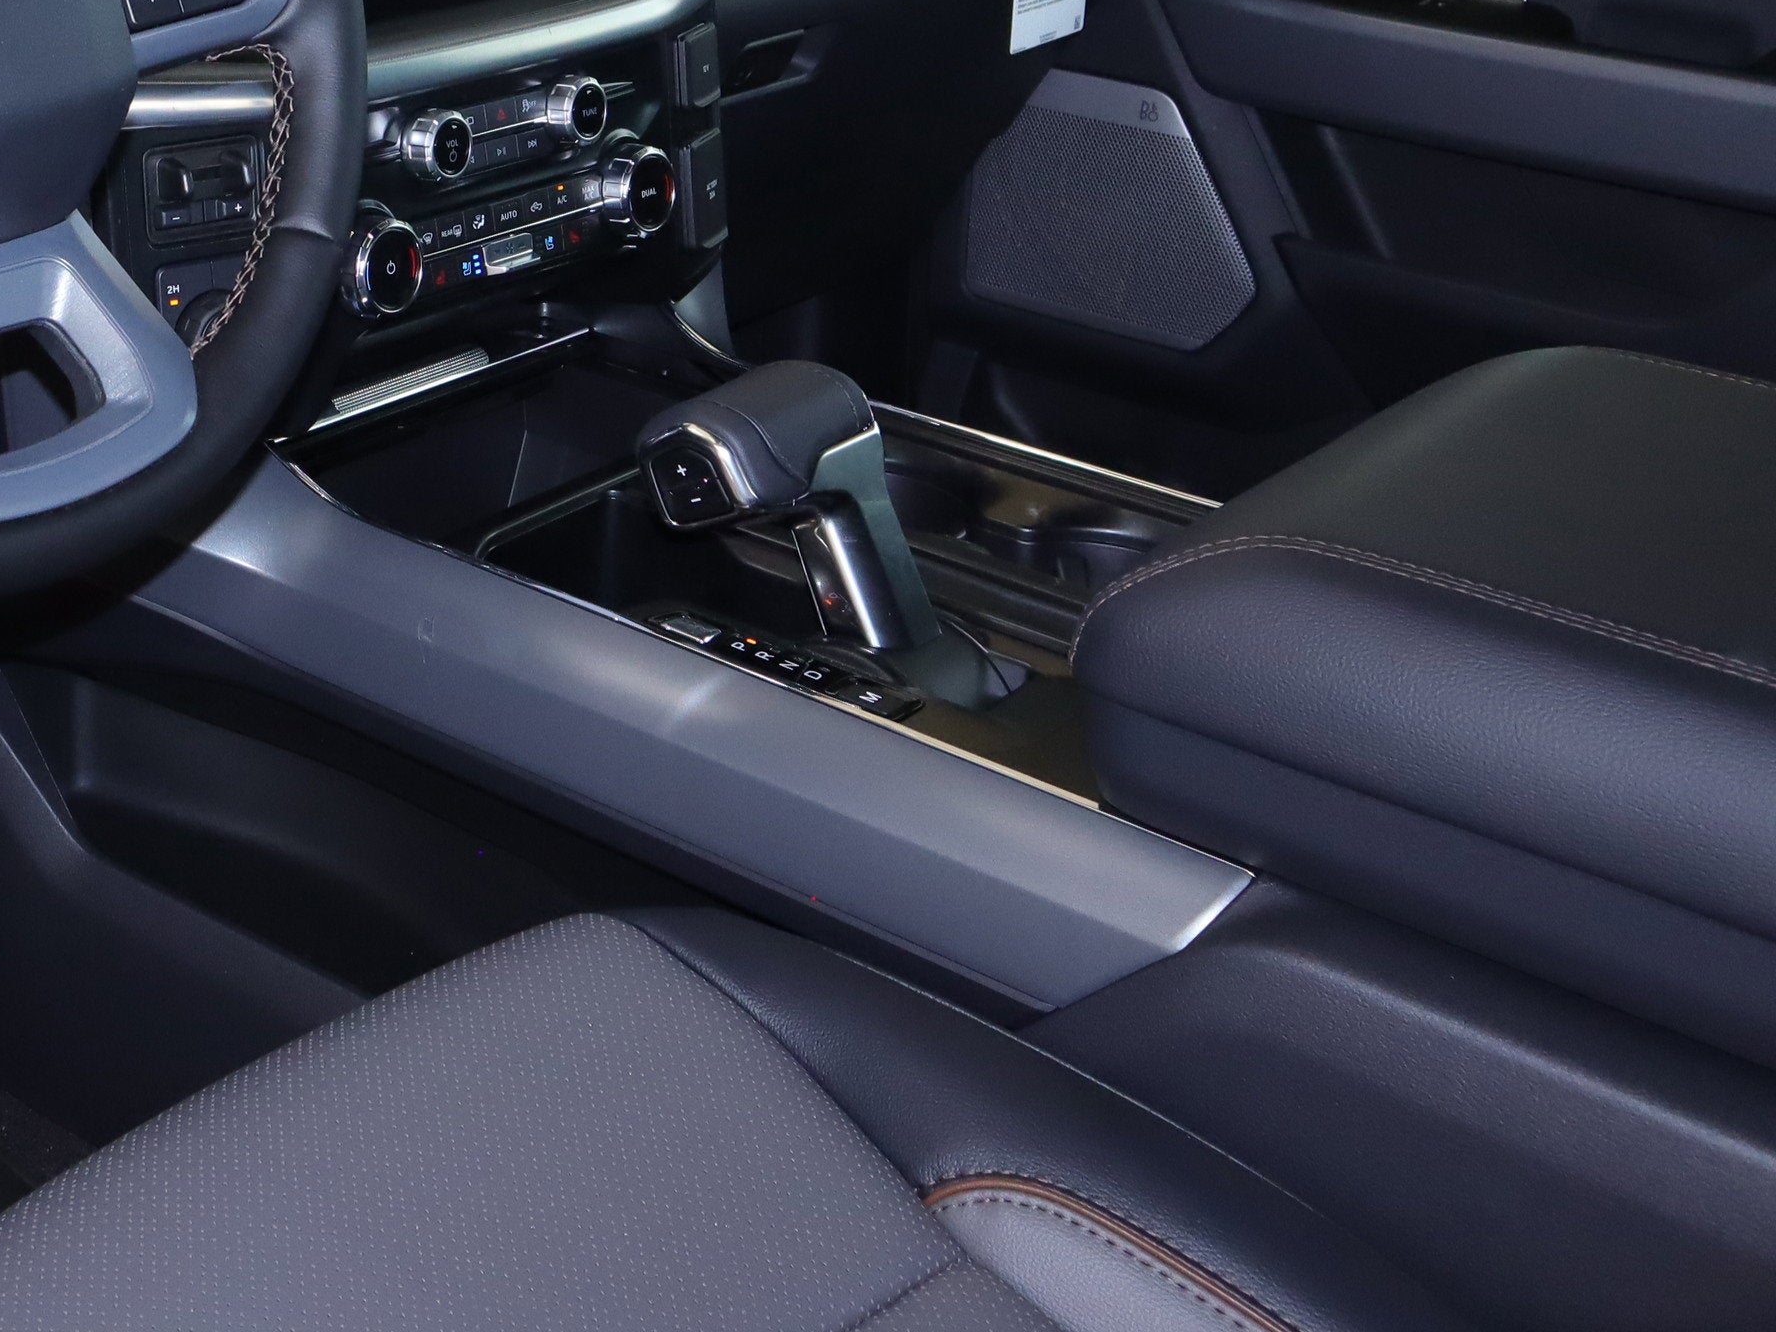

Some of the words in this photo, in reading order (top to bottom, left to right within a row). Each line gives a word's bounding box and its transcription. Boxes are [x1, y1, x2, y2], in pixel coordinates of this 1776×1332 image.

[581, 106, 598, 117] TUNE
[445, 139, 459, 149] VOL
[641, 186, 658, 199] DUAL
[556, 194, 568, 205] A/C
[500, 210, 518, 221] AUTO
[166, 284, 180, 295] 2H
[730, 641, 746, 652] P
[754, 650, 774, 661] R
[803, 670, 823, 681] D
